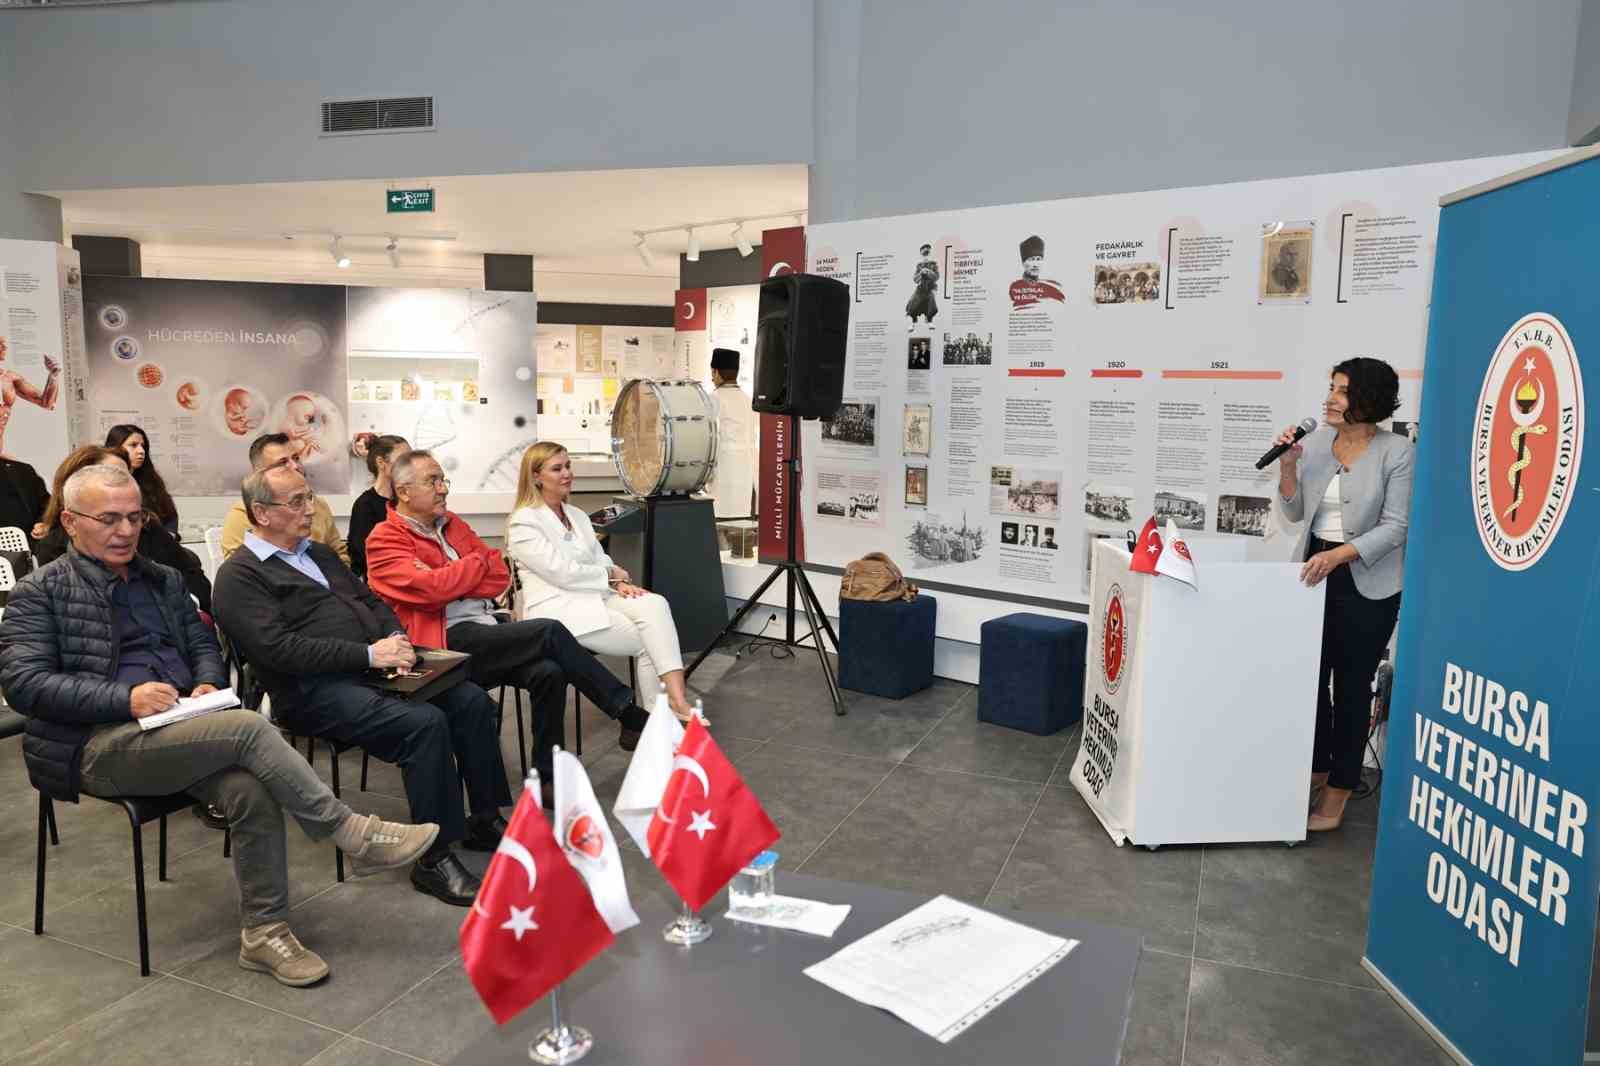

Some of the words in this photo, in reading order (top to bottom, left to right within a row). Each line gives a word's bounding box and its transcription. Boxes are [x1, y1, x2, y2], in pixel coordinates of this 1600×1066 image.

[148, 327, 235, 345] HÜCREDEN
[240, 329, 297, 345] İNSANA
[1211, 361, 1229, 369] 1921
[1478, 404, 1493, 461] BURSA
[1558, 406, 1574, 467] ODASI
[1094, 693, 1119, 735] BURSA
[1442, 662, 1550, 752] BURSA
[1083, 760, 1104, 799] ODASI
[1426, 851, 1524, 968] ODASI
